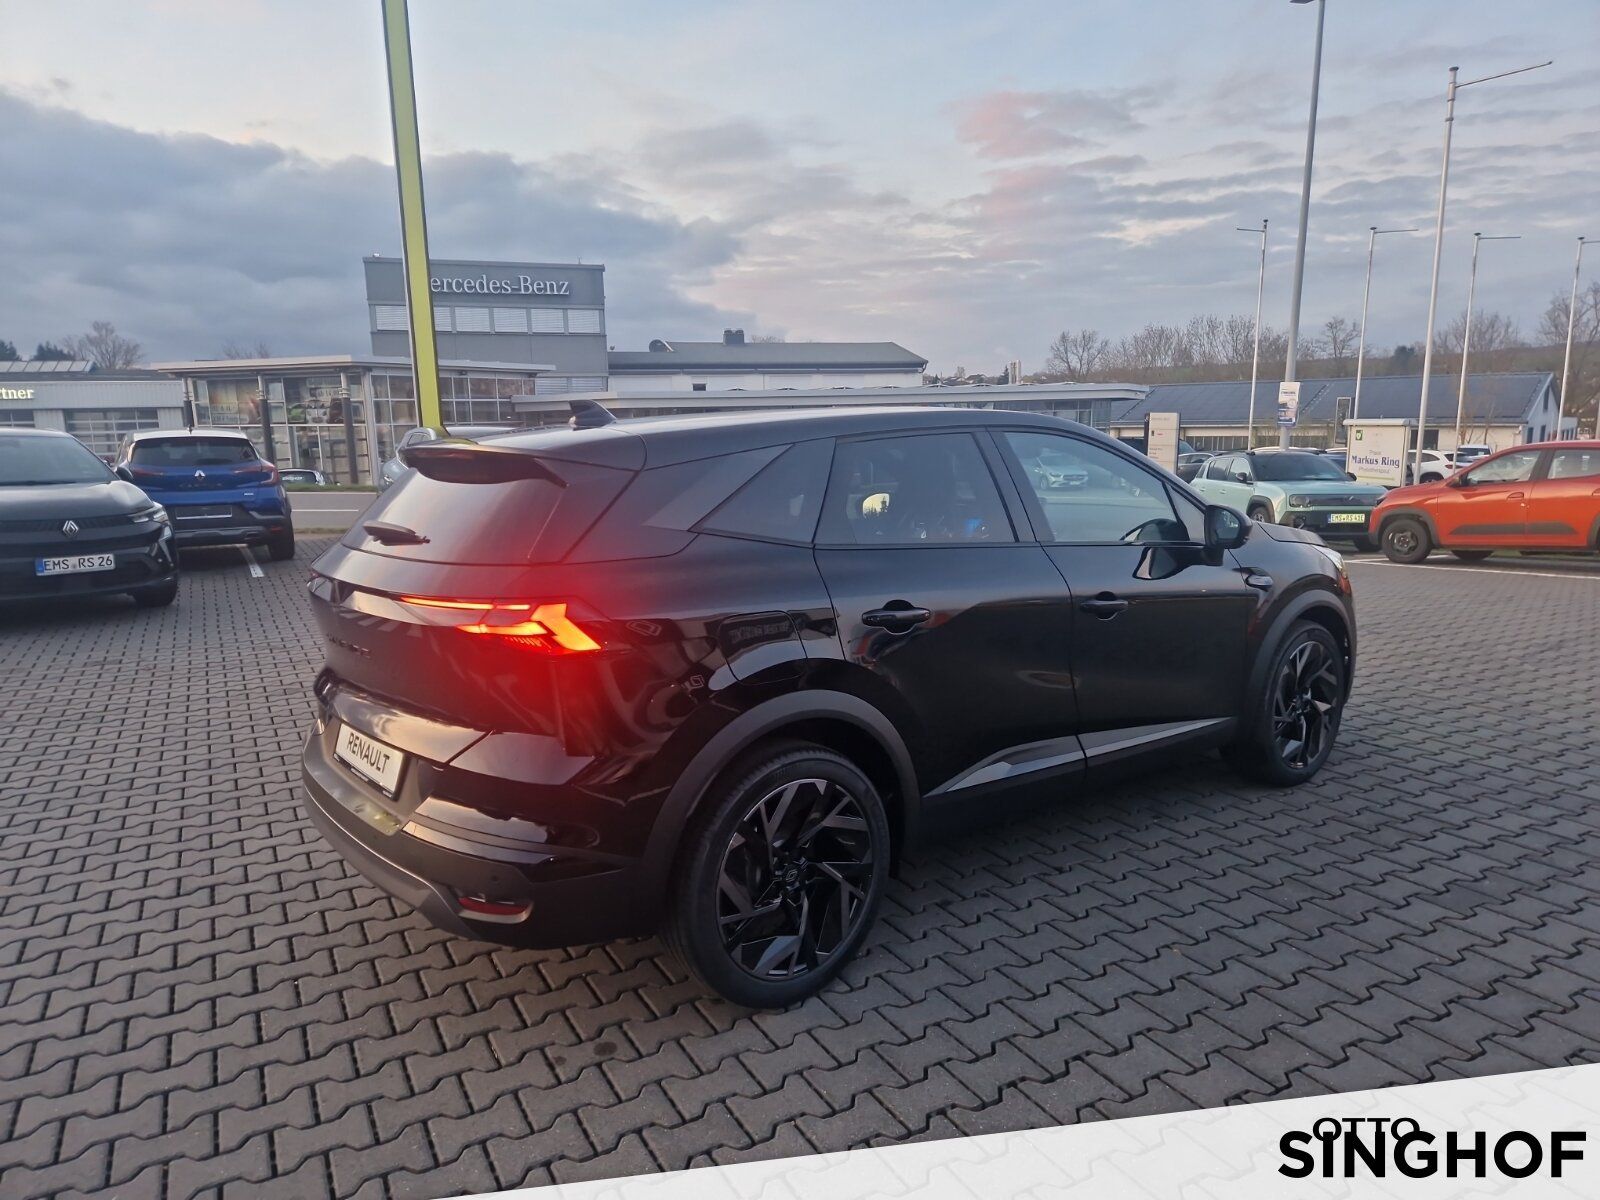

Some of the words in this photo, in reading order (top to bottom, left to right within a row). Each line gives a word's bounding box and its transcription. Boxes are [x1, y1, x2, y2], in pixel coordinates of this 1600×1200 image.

[430, 275, 570, 295] ercedes-Benz
[1351, 455, 1379, 465] Markus
[1381, 456, 1400, 468] Ring
[43, 559, 69, 571] EMS
[78, 557, 95, 568] RS
[97, 556, 113, 567] 26
[347, 732, 391, 774] RENAULT
